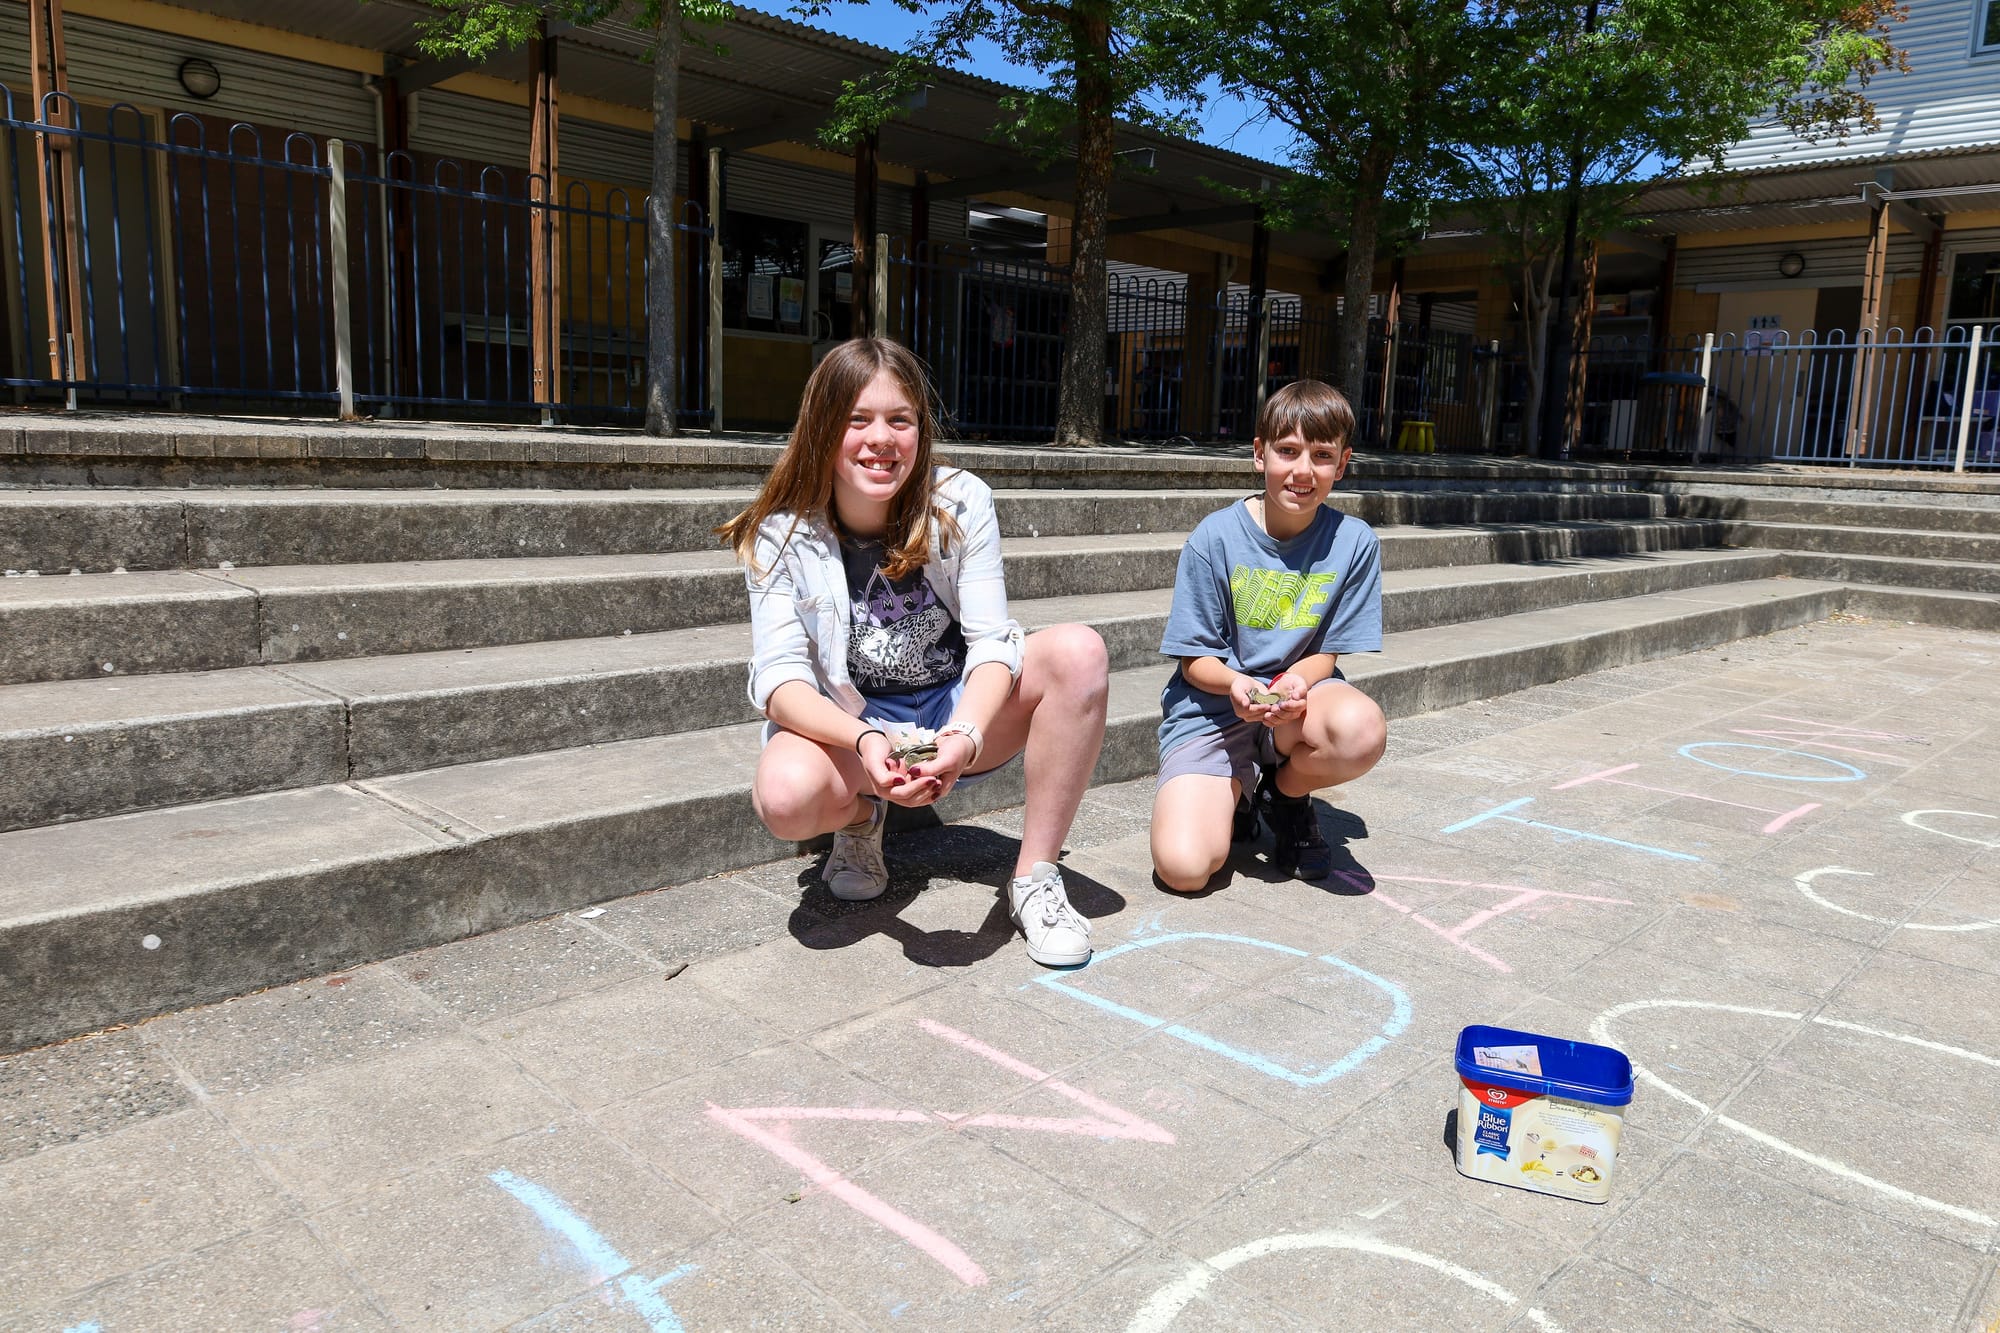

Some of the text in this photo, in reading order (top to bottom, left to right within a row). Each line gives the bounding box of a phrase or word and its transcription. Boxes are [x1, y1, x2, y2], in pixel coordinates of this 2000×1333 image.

[1230, 564, 1337, 630] NIKE
[1478, 1119, 1509, 1133] Ribbon
[1483, 1112, 1506, 1126] Blue
